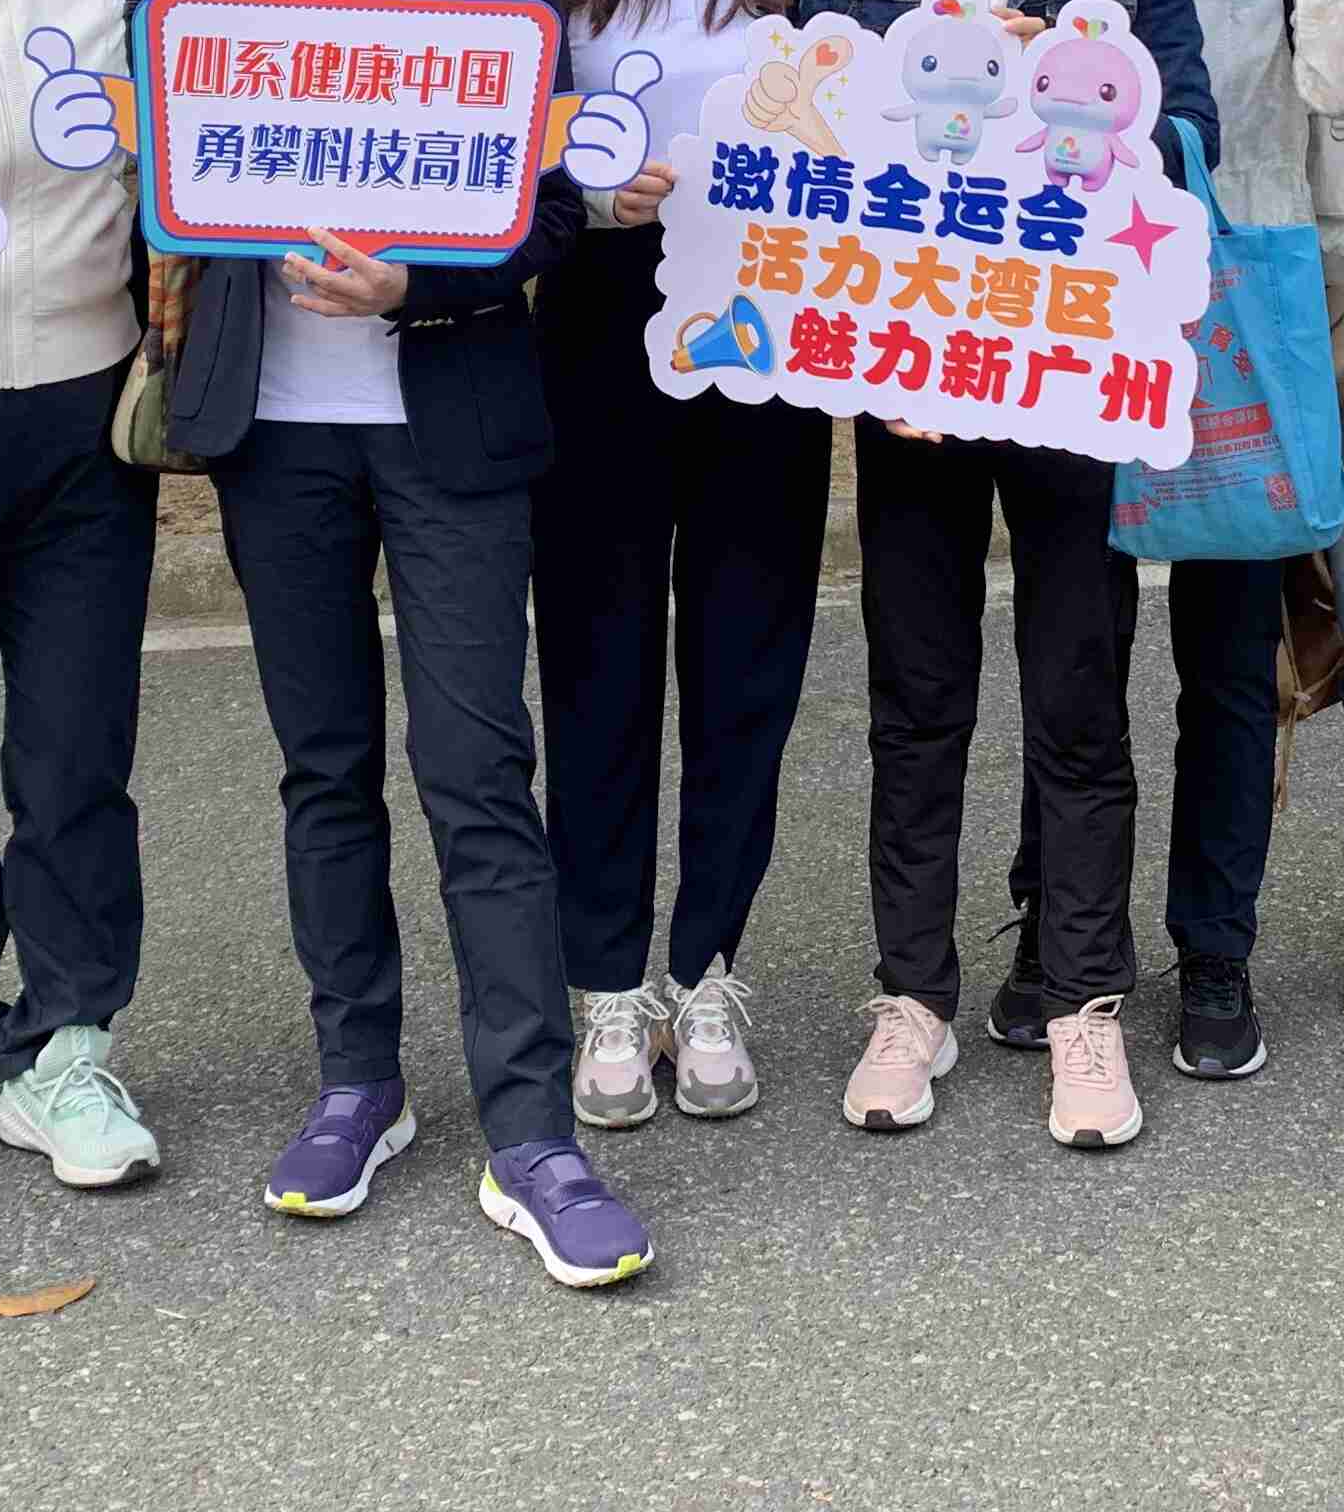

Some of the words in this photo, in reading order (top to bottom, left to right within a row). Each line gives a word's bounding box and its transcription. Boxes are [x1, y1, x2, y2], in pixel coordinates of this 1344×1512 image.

[172, 35, 513, 109] 心系健康中国
[193, 123, 518, 192] 勇攀科技高峰
[708, 141, 1089, 256] 激情全运会
[737, 223, 1119, 341] 活力大湾区
[786, 307, 1173, 430] 魅力新广州
